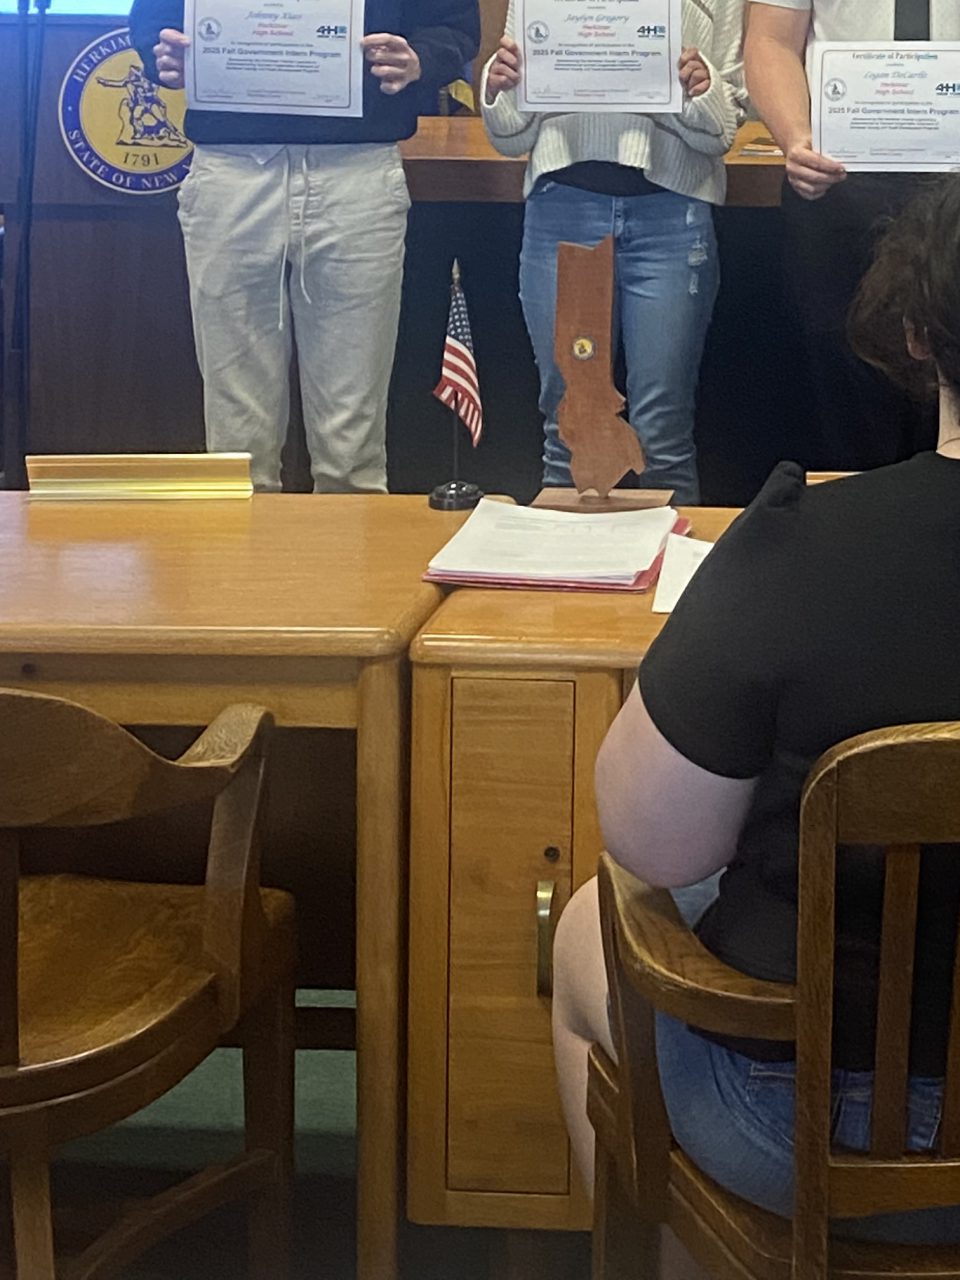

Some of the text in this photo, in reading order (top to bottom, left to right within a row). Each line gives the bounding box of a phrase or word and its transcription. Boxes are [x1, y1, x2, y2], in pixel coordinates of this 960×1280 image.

[238, 48, 284, 56] Government
[896, 53, 939, 61] Participation
[862, 107, 905, 115] Government
[930, 107, 960, 115] Program
[69, 129, 178, 189] STATE OF NEW
[122, 151, 160, 167] 1791
